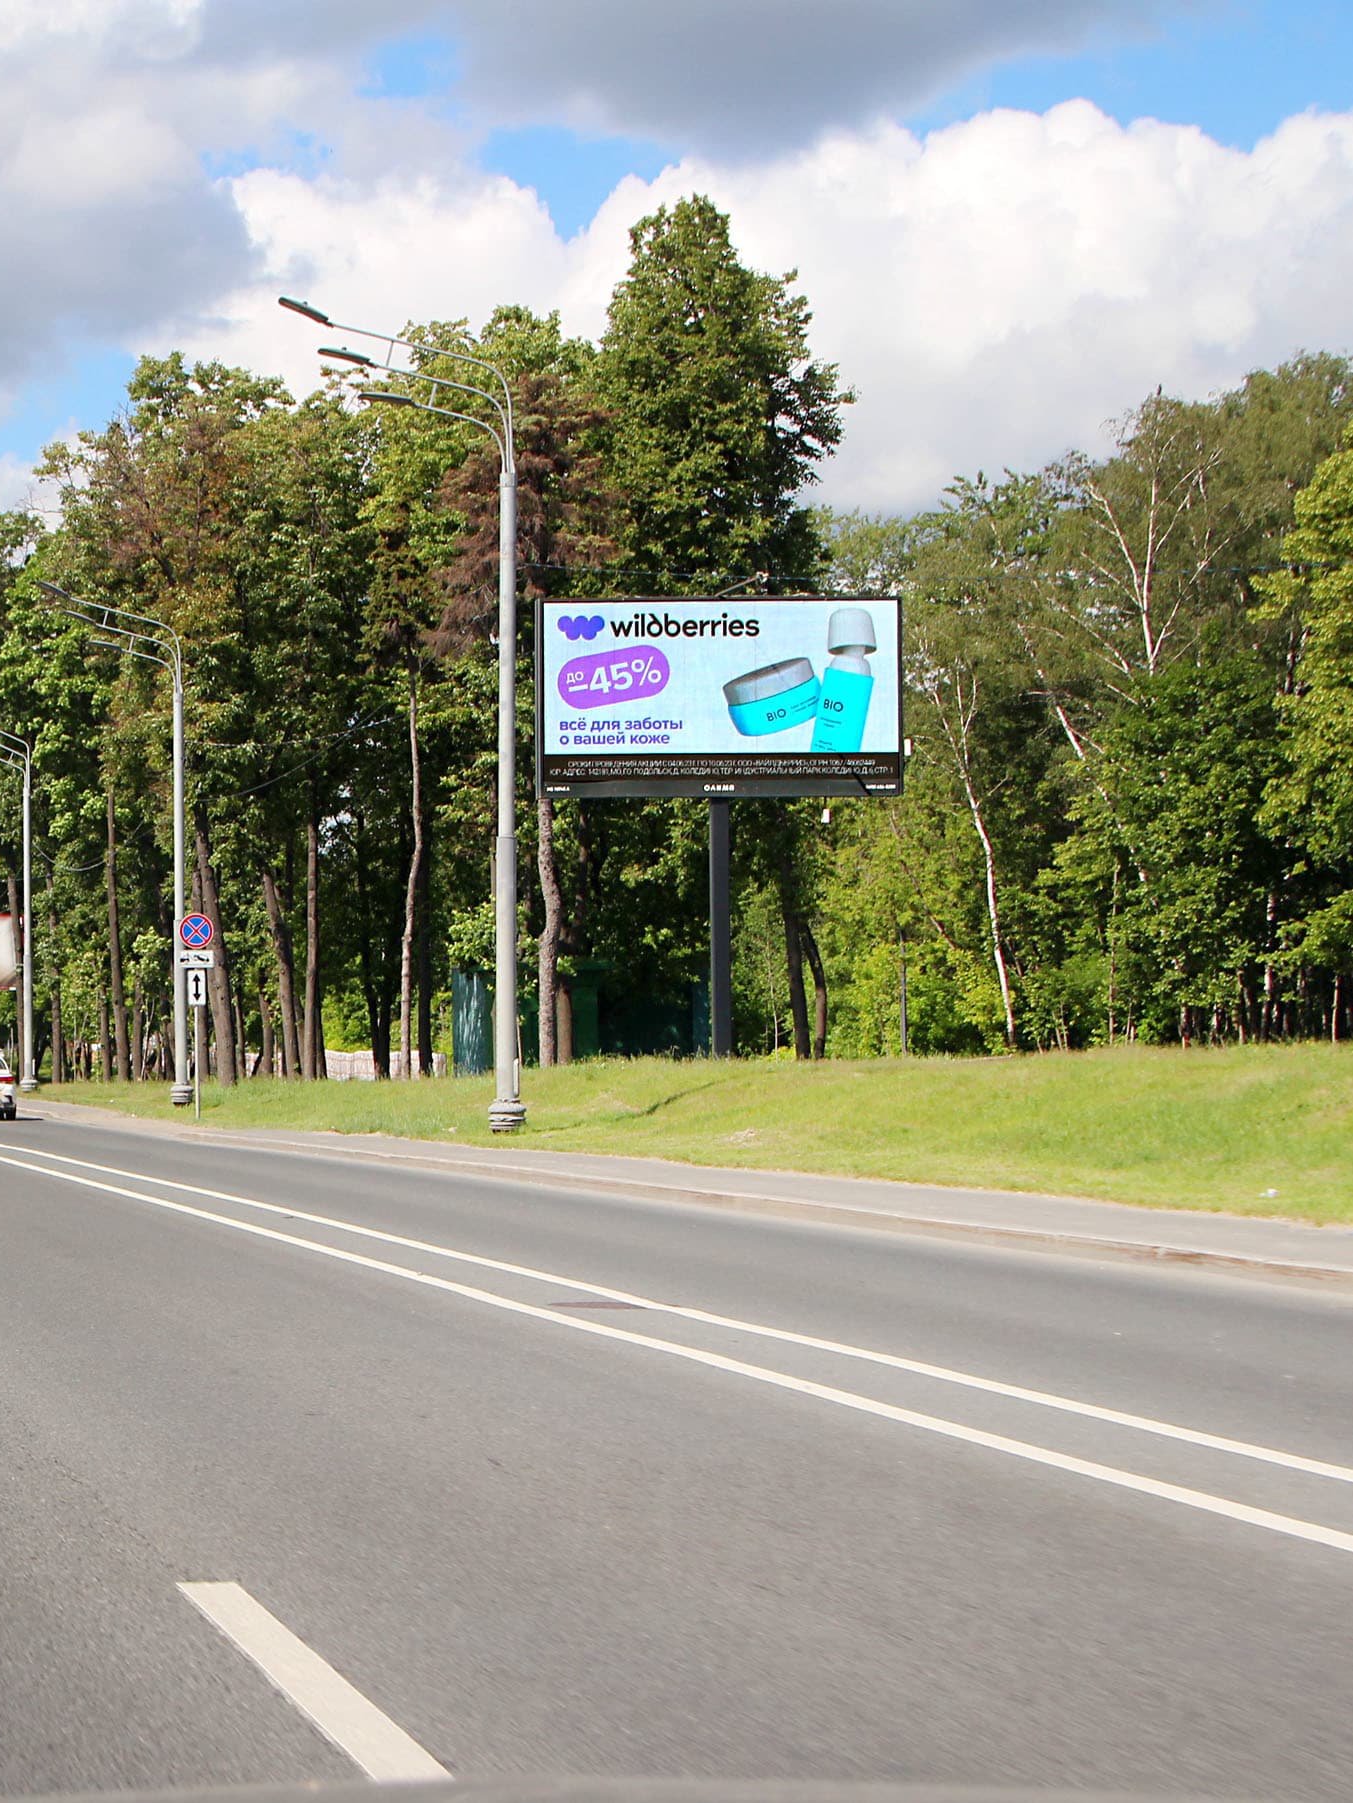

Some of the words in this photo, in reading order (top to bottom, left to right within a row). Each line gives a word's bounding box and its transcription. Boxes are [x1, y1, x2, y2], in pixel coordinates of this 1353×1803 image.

[610, 612, 760, 638] wildberries
[822, 698, 844, 712] BIO
[766, 708, 786, 722] BIO
[559, 717, 587, 731] всё
[590, 720, 621, 732] для
[624, 716, 683, 730] заботы
[559, 735, 570, 745] о
[573, 731, 625, 745] вашей
[630, 734, 670, 744] коже
